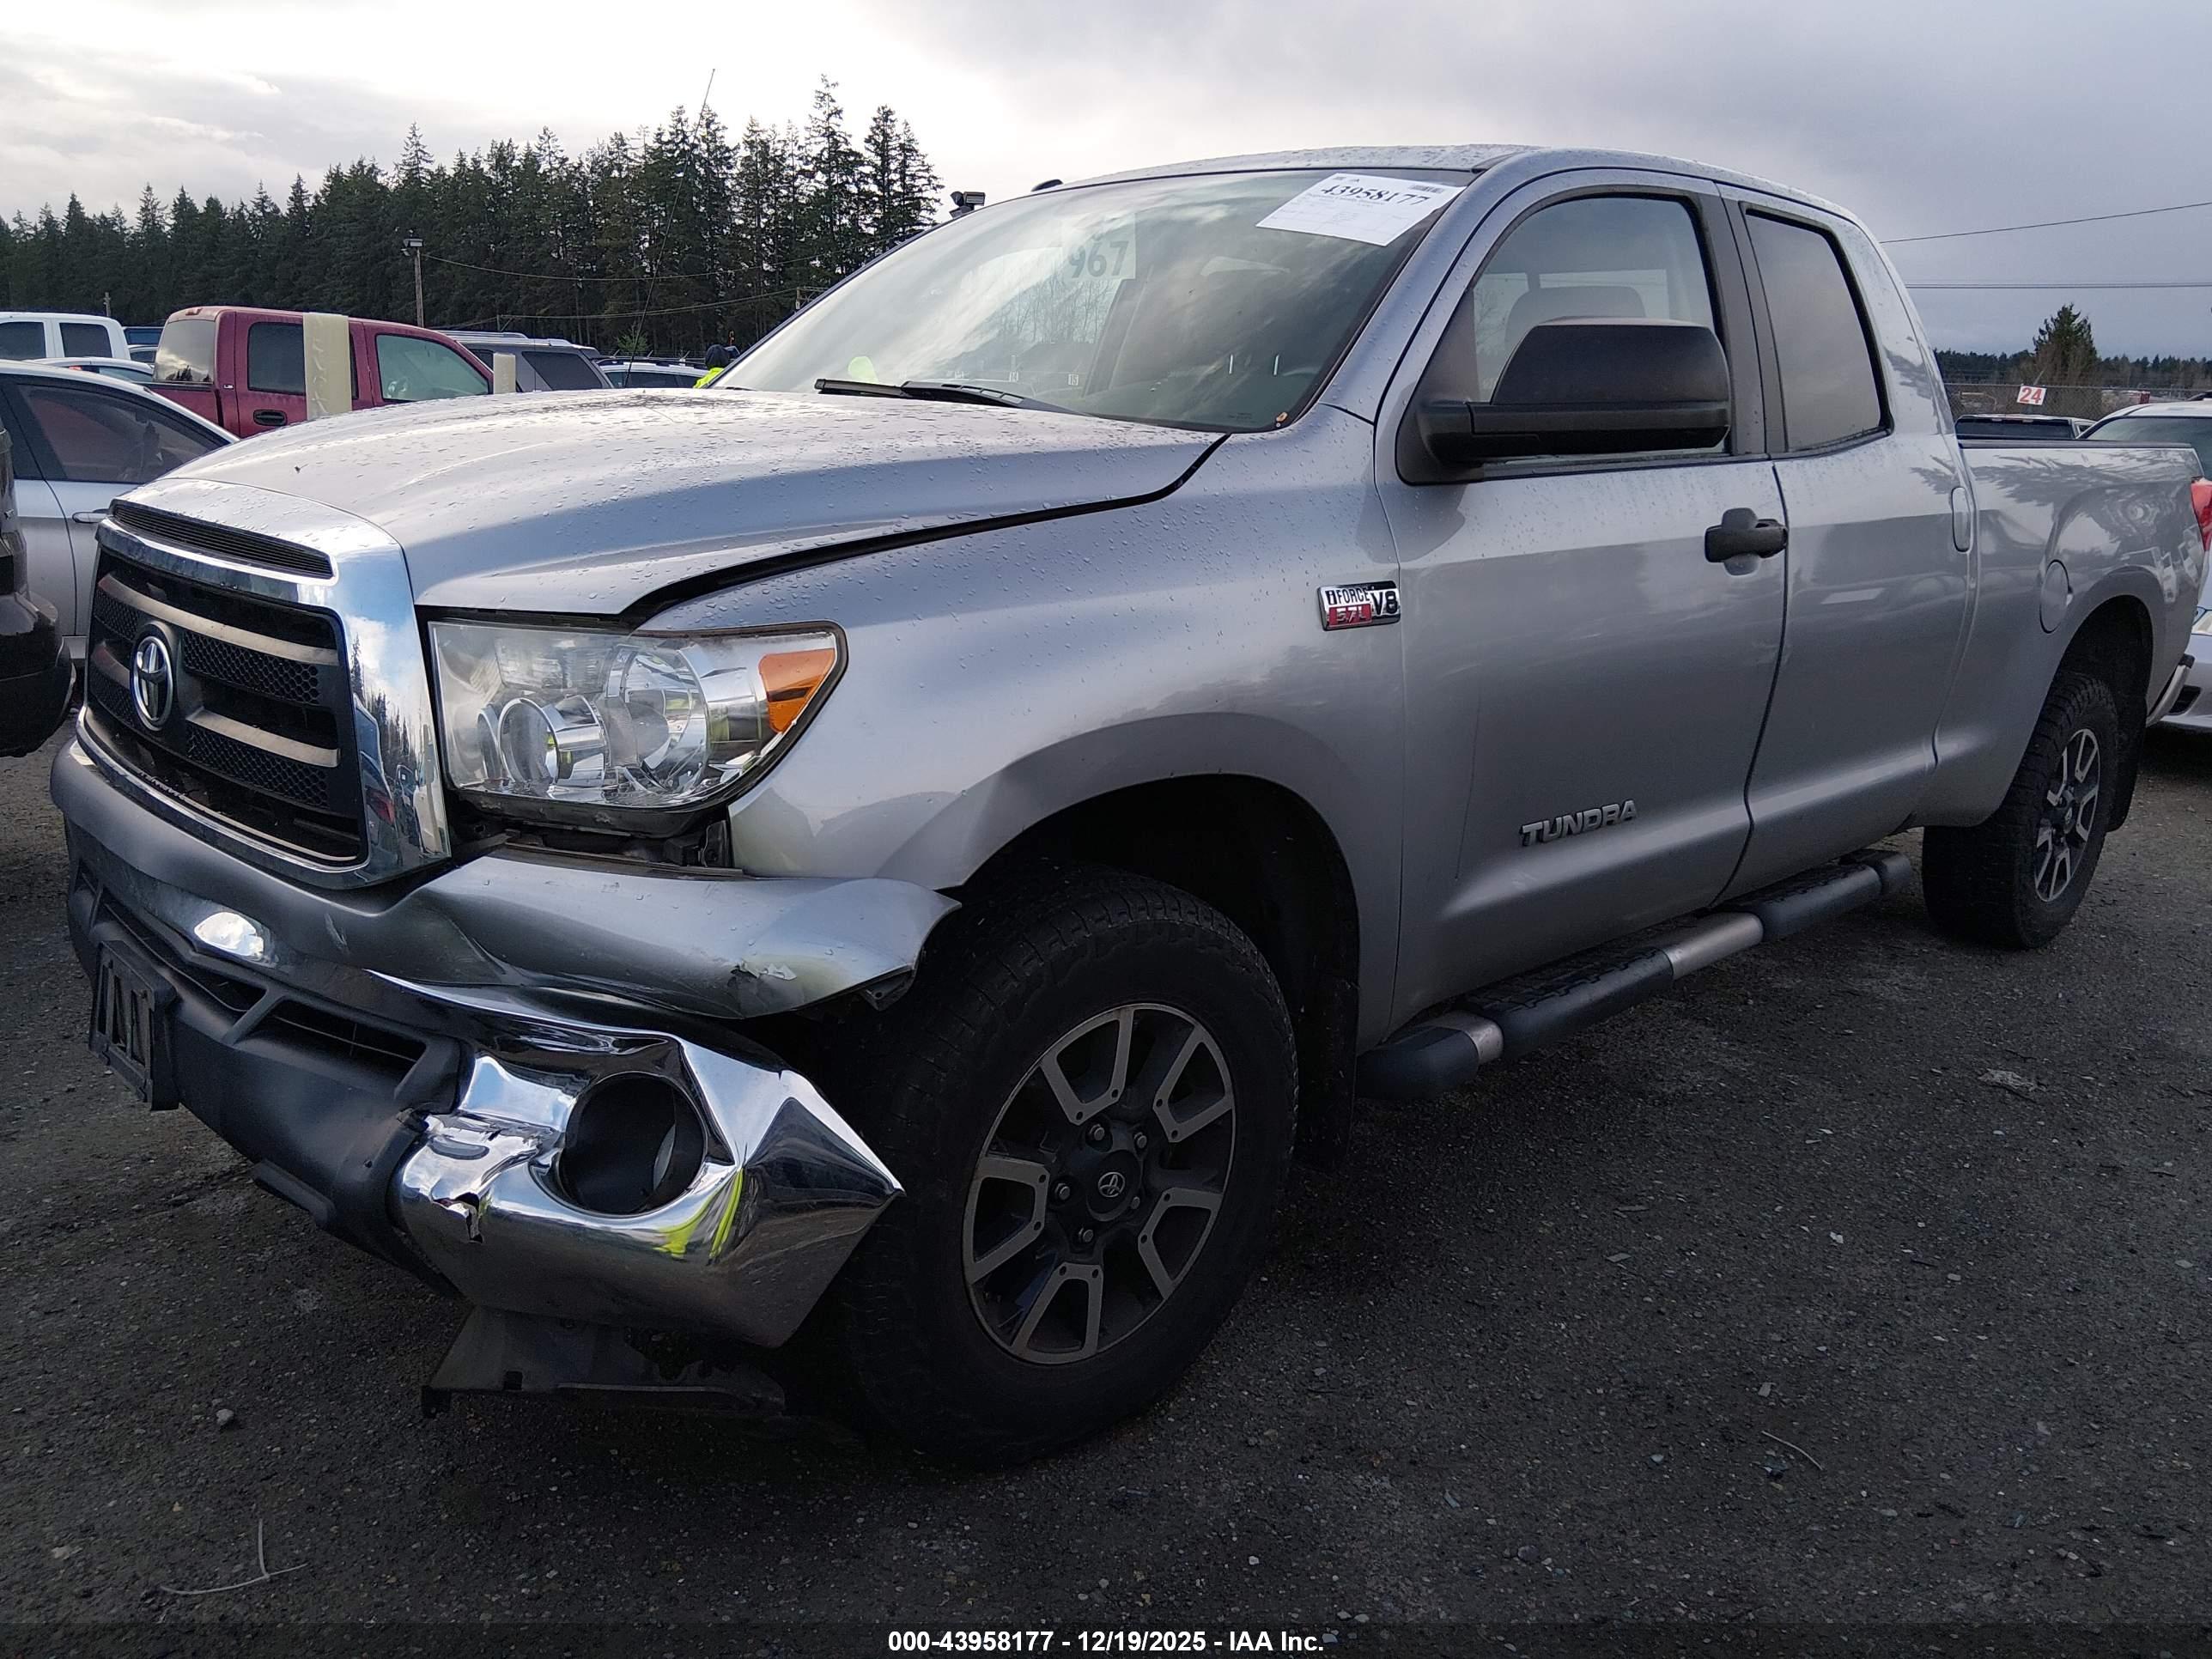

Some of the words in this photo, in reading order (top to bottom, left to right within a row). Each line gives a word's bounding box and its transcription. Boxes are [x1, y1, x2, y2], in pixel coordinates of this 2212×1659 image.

[1321, 184, 1431, 206] 43958177
[1067, 239, 1130, 279] 967
[2019, 386, 2043, 404] 24
[1335, 605, 1367, 623] 5.7L
[1371, 590, 1399, 616] V8
[1520, 799, 1638, 847] TUNDRA
